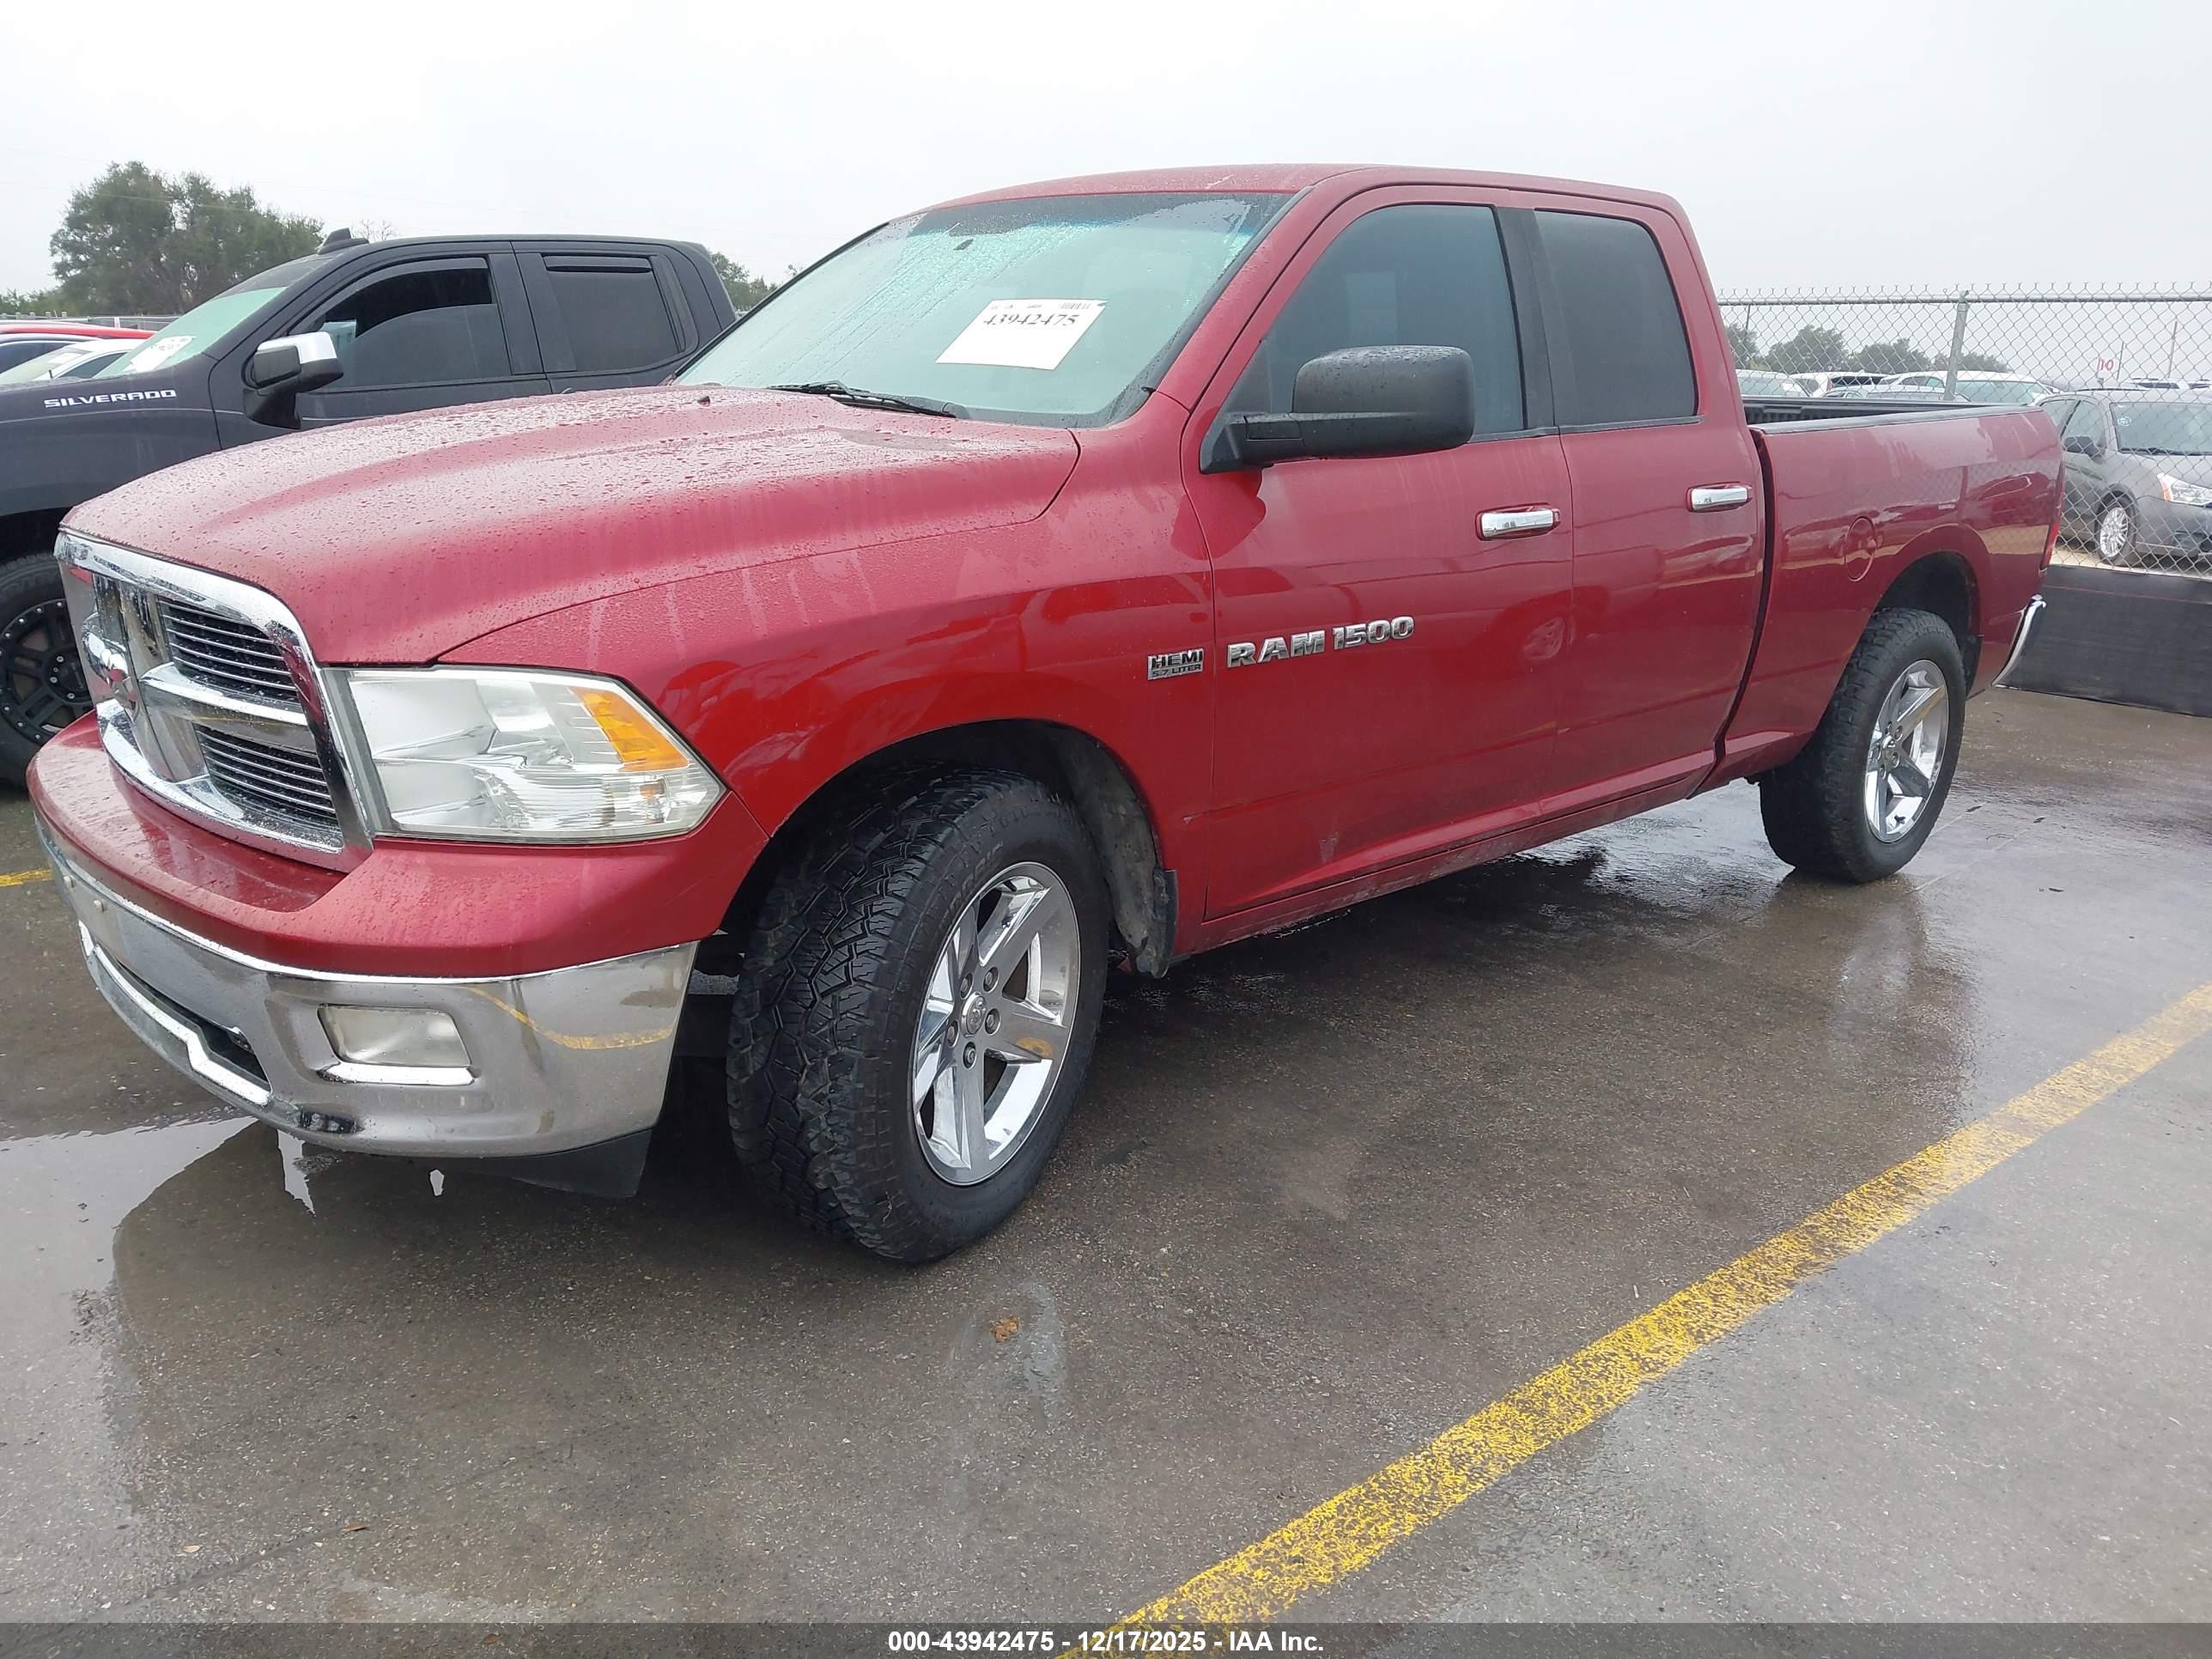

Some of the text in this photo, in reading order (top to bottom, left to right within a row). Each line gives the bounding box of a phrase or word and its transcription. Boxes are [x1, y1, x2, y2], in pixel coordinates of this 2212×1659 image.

[983, 313, 1079, 325] 43942475
[44, 389, 177, 408] SILVERADO
[1228, 617, 1414, 667] RAM 1500
[1152, 650, 1204, 668] HEMI
[1171, 664, 1202, 674] LITER
